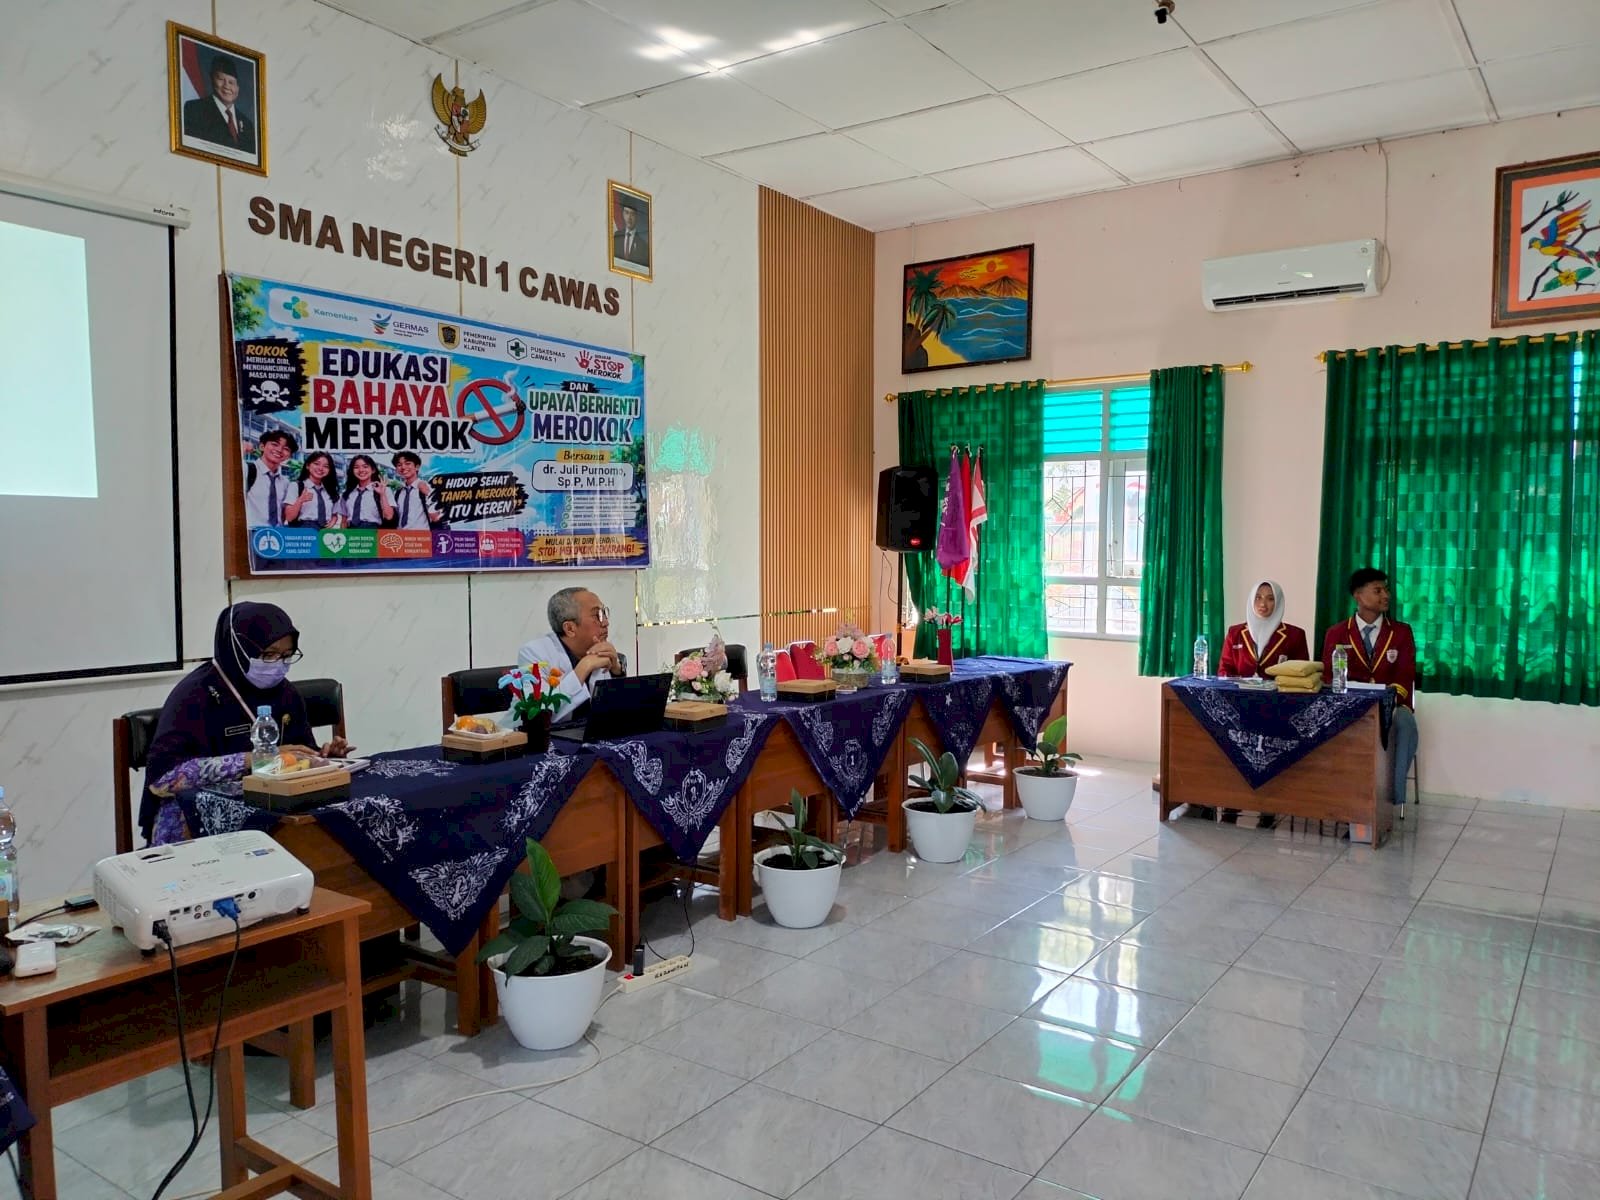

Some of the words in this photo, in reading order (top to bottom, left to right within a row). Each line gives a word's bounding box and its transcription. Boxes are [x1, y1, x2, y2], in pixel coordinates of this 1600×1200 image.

[248, 196, 344, 254] SMA
[352, 222, 487, 287] NEGERI
[495, 260, 509, 292] 1
[519, 267, 620, 316] CAWAS
[313, 308, 358, 321] Kemenkes
[393, 321, 429, 333] GERMAS
[463, 331, 497, 341] PEMERINTAH
[463, 338, 496, 348] KABUPATEN
[463, 344, 485, 352] KLATEN
[246, 345, 288, 357] ROKOK
[530, 346, 566, 358] PUSKESMAS
[246, 356, 275, 364] MERUSAK
[530, 353, 552, 362] CAWAS
[243, 364, 296, 373] MENGHANCURKAN
[322, 347, 448, 383] EDUKASI
[594, 359, 624, 372] STOP
[587, 368, 622, 379] MEROKOK
[569, 382, 588, 392] DAN
[313, 378, 450, 418] BAHAYA
[529, 391, 574, 412] UPAYA
[580, 394, 639, 416] BERHENTI
[304, 416, 472, 450] MEROKOK
[533, 413, 632, 442] MEROKOK
[563, 450, 605, 461] Bersama
[543, 464, 556, 474] dr.
[560, 465, 578, 475] Juli
[480, 475, 510, 487] SEHAT
[441, 490, 473, 502] TANPA
[475, 487, 519, 499] MEROKOK
[449, 504, 472, 518] ITU
[545, 537, 565, 546] MULAI
[567, 537, 580, 545] DRI
